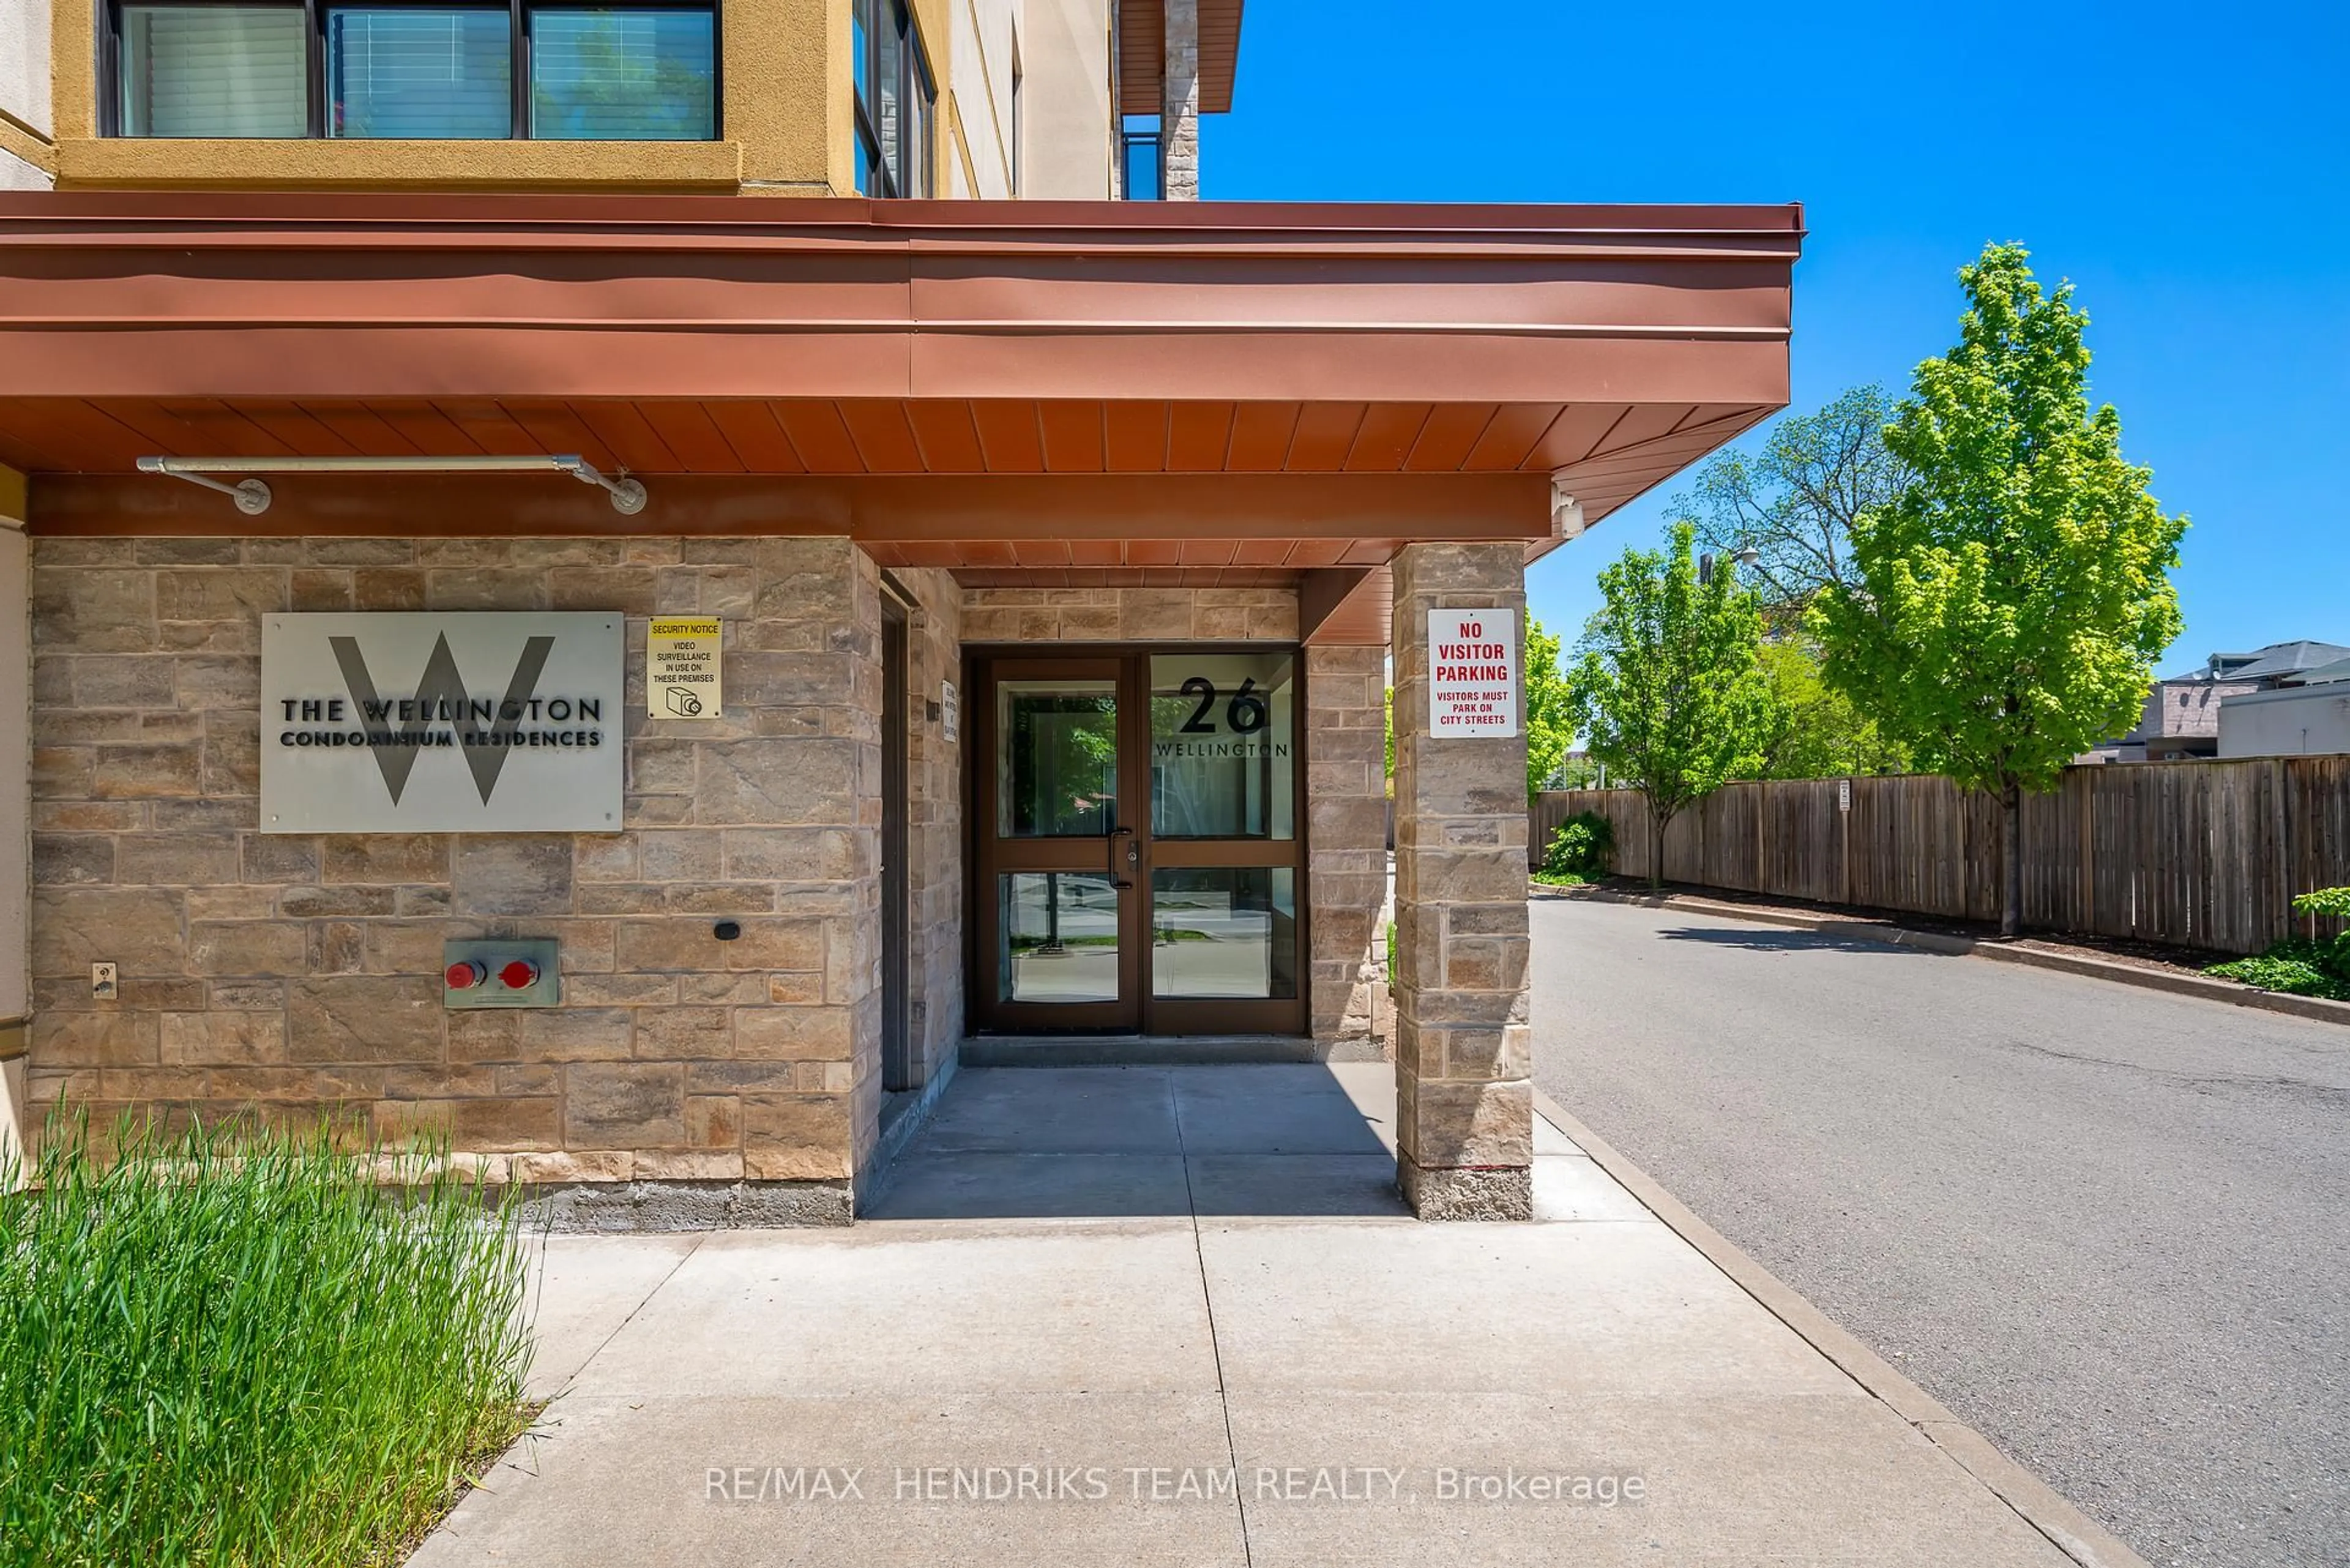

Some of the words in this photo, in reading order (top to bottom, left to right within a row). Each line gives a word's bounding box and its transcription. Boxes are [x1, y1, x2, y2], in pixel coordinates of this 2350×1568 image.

[652, 625, 689, 633] SECURITY
[690, 625, 718, 633] NOTICE
[1460, 623, 1482, 638] NO
[1439, 644, 1504, 659] VISITOR
[1437, 666, 1507, 681] PARKING
[1437, 692, 1479, 701] VISITORS
[1482, 692, 1508, 700] MUST
[281, 700, 343, 721] THE
[363, 699, 600, 722] WELLINGTON
[1179, 676, 1265, 734] 26
[1453, 704, 1477, 712] PARK
[328, 629, 556, 807] W
[1441, 715, 1462, 725] CITY
[1465, 715, 1505, 724] STREETS
[280, 731, 453, 746] CONDOMINIUM
[465, 731, 600, 746] RESIDENCES
[1157, 744, 1288, 756] WELLINGTON
